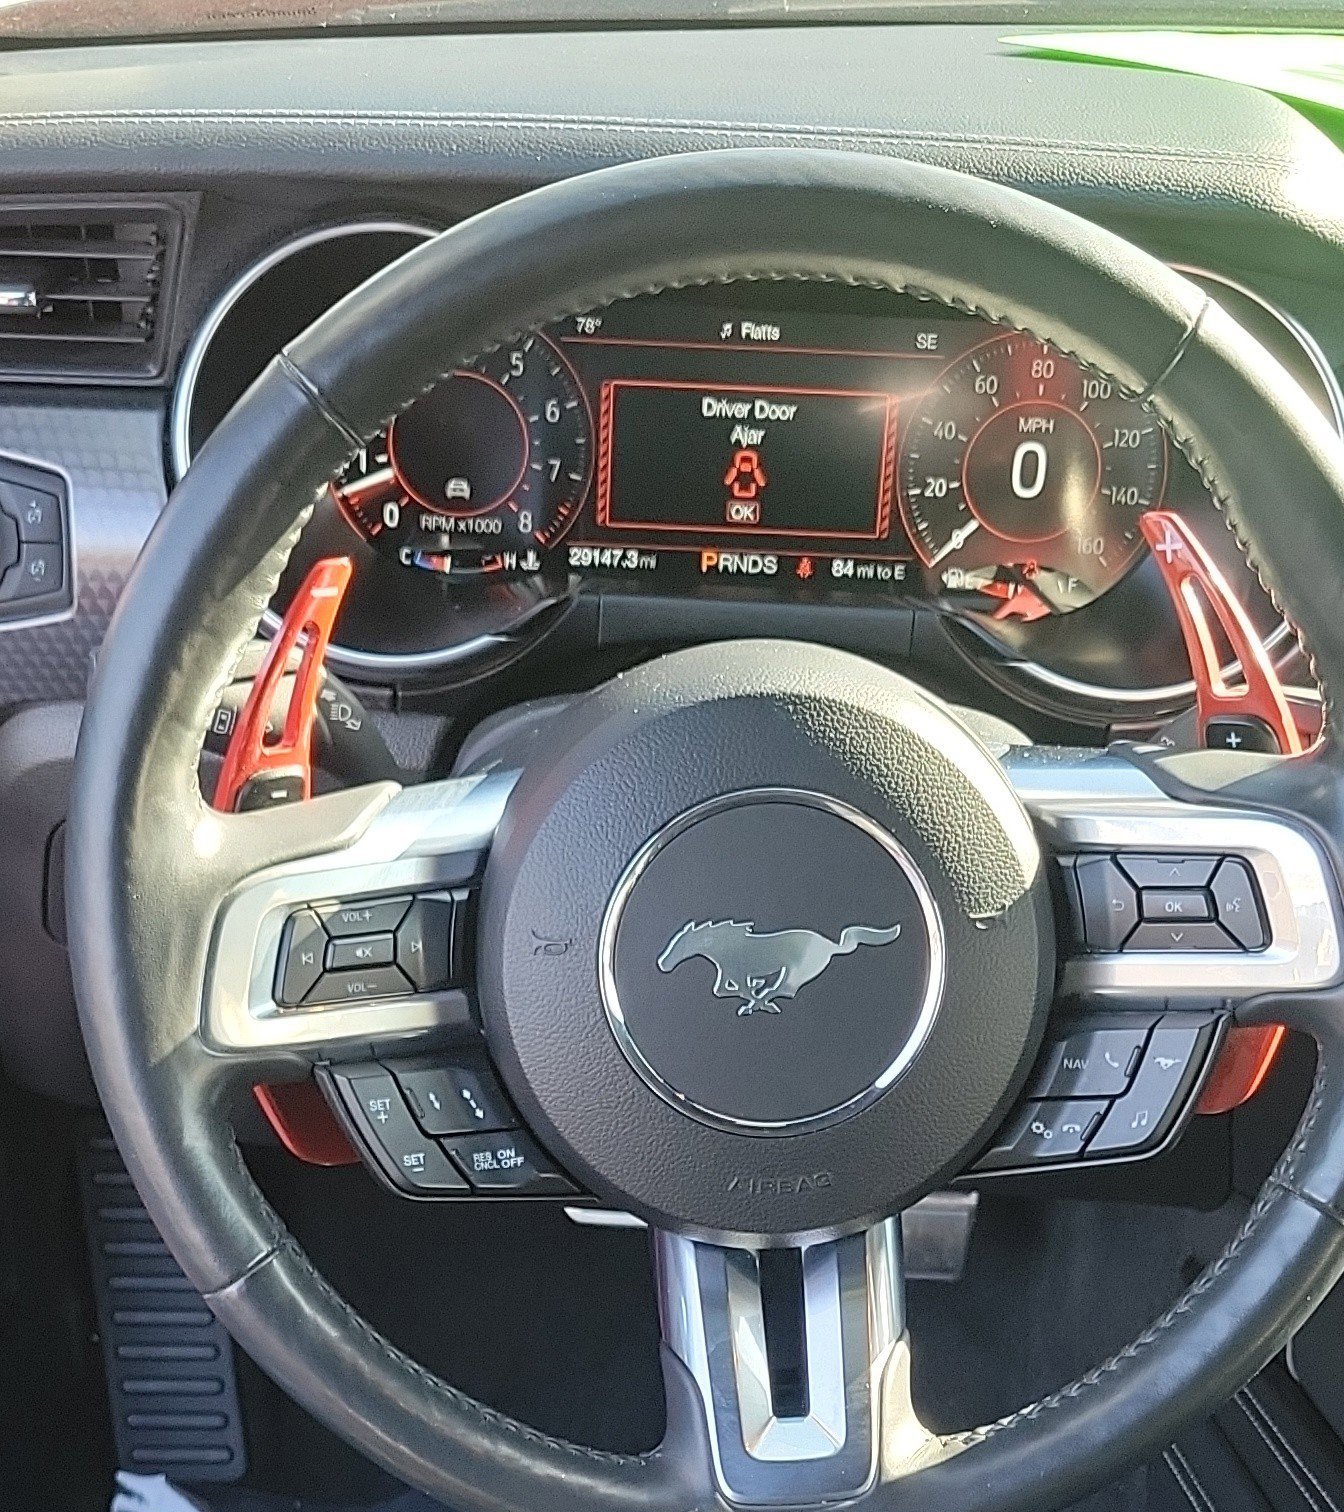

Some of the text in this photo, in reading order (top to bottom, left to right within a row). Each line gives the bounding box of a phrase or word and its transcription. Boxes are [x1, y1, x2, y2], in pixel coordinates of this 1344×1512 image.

[916, 334, 938, 349] SE
[509, 352, 524, 375] 5
[1030, 359, 1054, 379] 80
[975, 376, 999, 396] 60
[1082, 378, 1111, 401] 100
[546, 401, 560, 422] 6
[701, 398, 798, 421] Driver Door
[934, 420, 957, 441] 40
[1018, 416, 1055, 434] MPH
[730, 424, 765, 448] Ajar
[1113, 428, 1141, 449] 120
[548, 460, 561, 482] 7
[1011, 441, 1048, 499] 0
[923, 478, 947, 498] 20
[1111, 486, 1139, 506] 140
[383, 501, 399, 528] 0
[420, 513, 455, 532] RPM
[518, 510, 532, 533] 8
[729, 504, 755, 521] OK
[399, 547, 411, 565] C
[1077, 537, 1104, 555] 160
[568, 547, 639, 569] 29147.3
[831, 559, 854, 578] 84
[1067, 576, 1078, 593] F
[1164, 901, 1183, 913] OK
[1063, 1056, 1089, 1071] NAV
[369, 1097, 391, 1112] SET
[403, 1154, 425, 1168] SET
[497, 1147, 516, 1160] ON
[501, 1156, 524, 1168] OFF
[727, 1172, 835, 1195] AIRBAG
